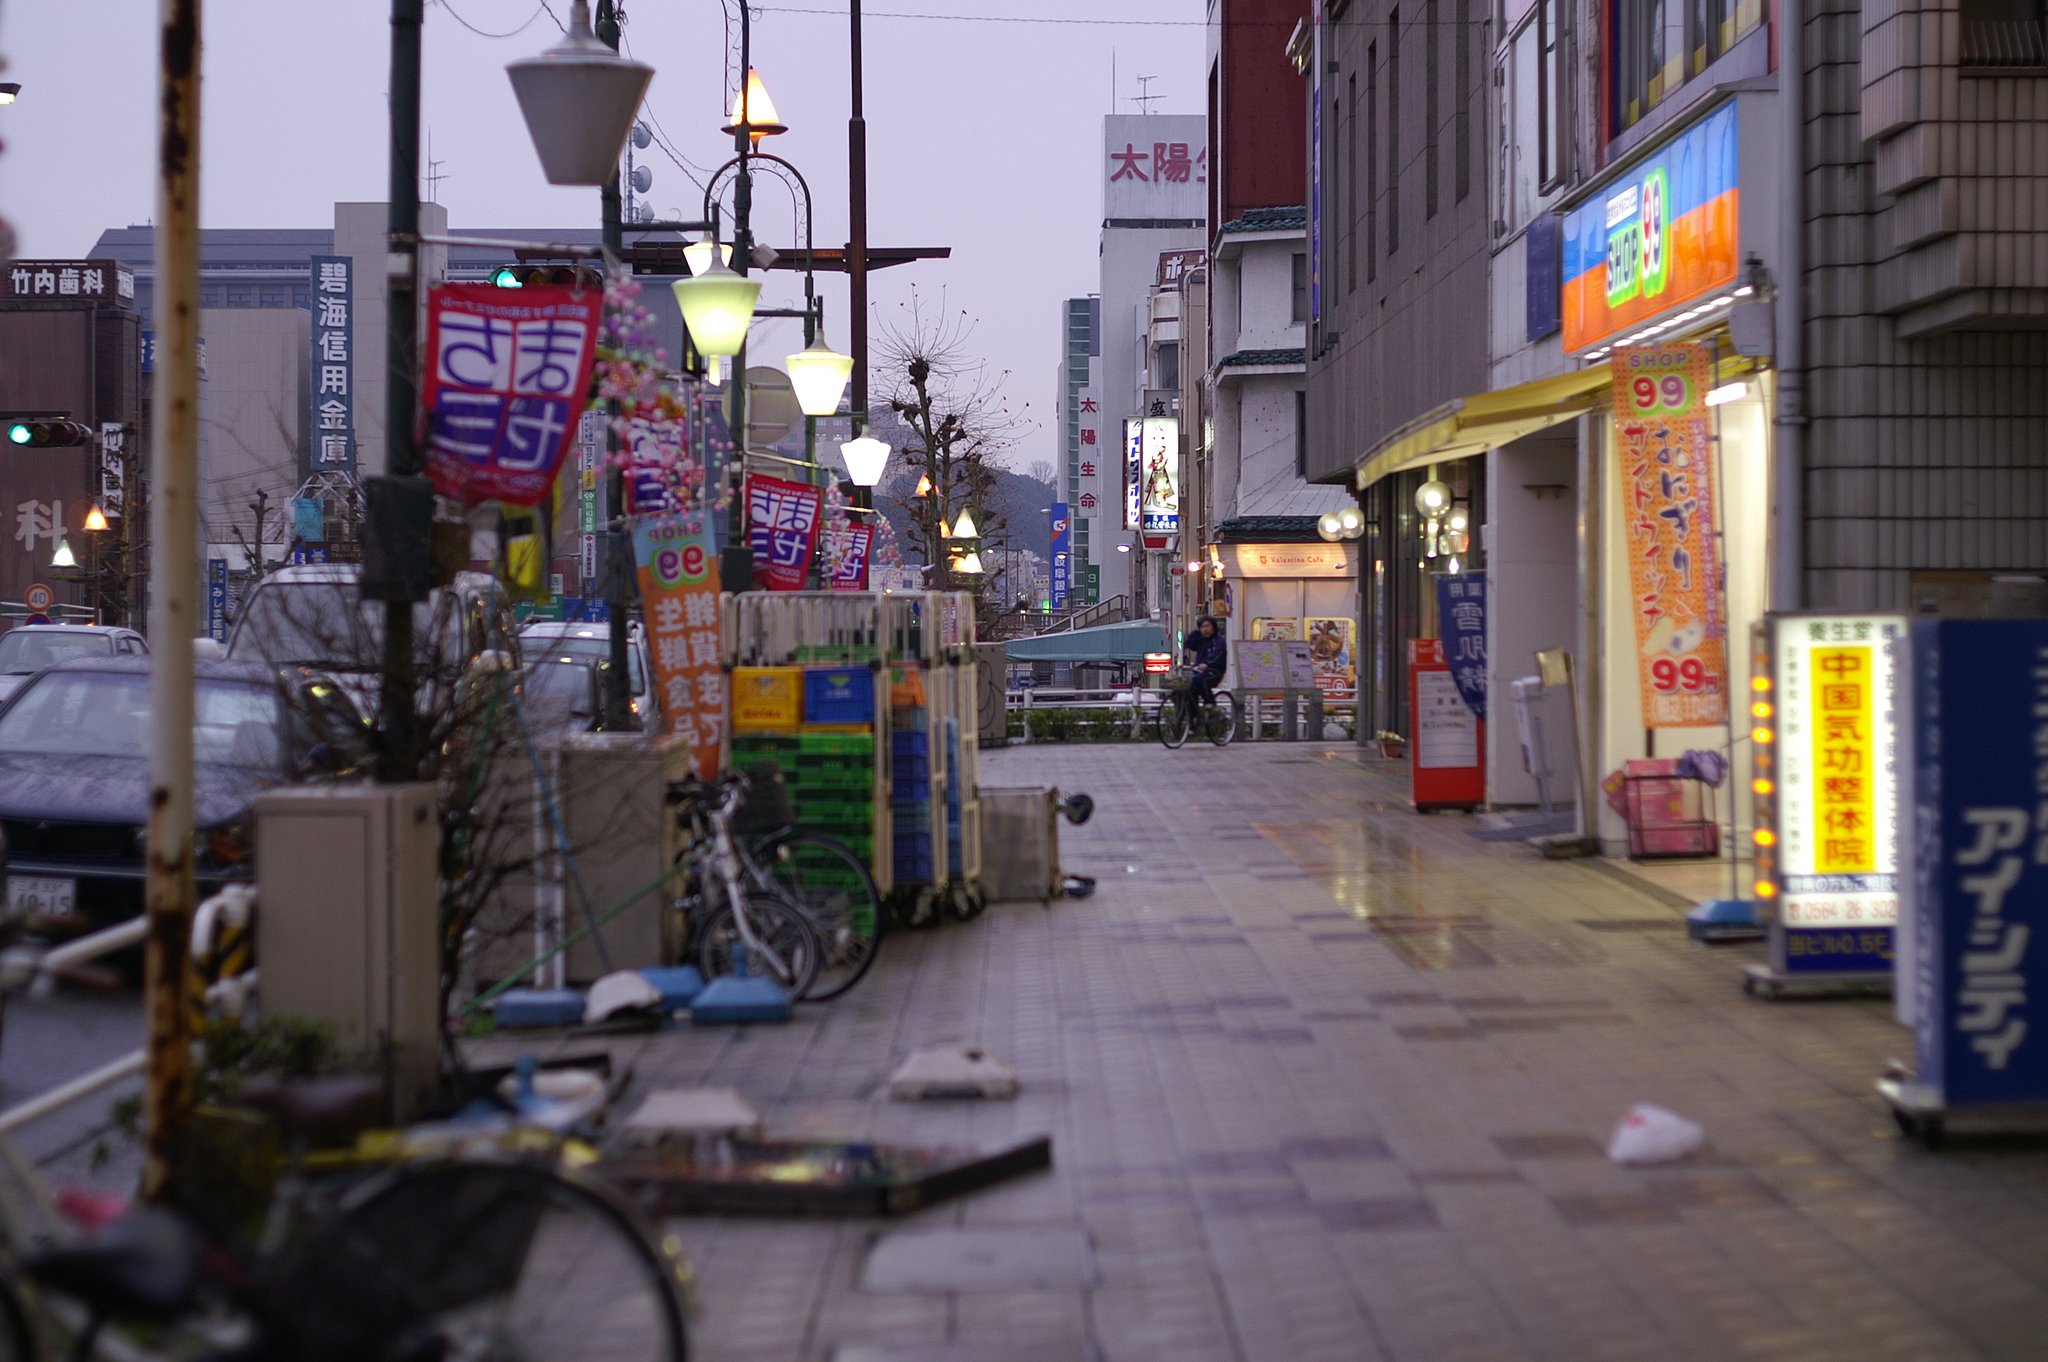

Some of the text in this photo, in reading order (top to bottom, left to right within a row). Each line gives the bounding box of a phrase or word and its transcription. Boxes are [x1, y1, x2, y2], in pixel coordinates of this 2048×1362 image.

[1110, 142, 1206, 183] 太陽
[1606, 226, 1638, 294] SHOP
[1642, 174, 1663, 278] 99
[11, 268, 104, 295] 竹内歯科
[319, 262, 348, 464] 碧海信用金庫
[1630, 353, 1687, 368] SHOP
[1633, 374, 1687, 409] 99
[1080, 397, 1096, 509] 太陽生命
[1654, 421, 1697, 590] おにぎり
[1270, 555, 1324, 564] Valentine Cafe
[1820, 652, 1865, 867] 中国気功整体院
[1956, 807, 2029, 1069] アイシティ
